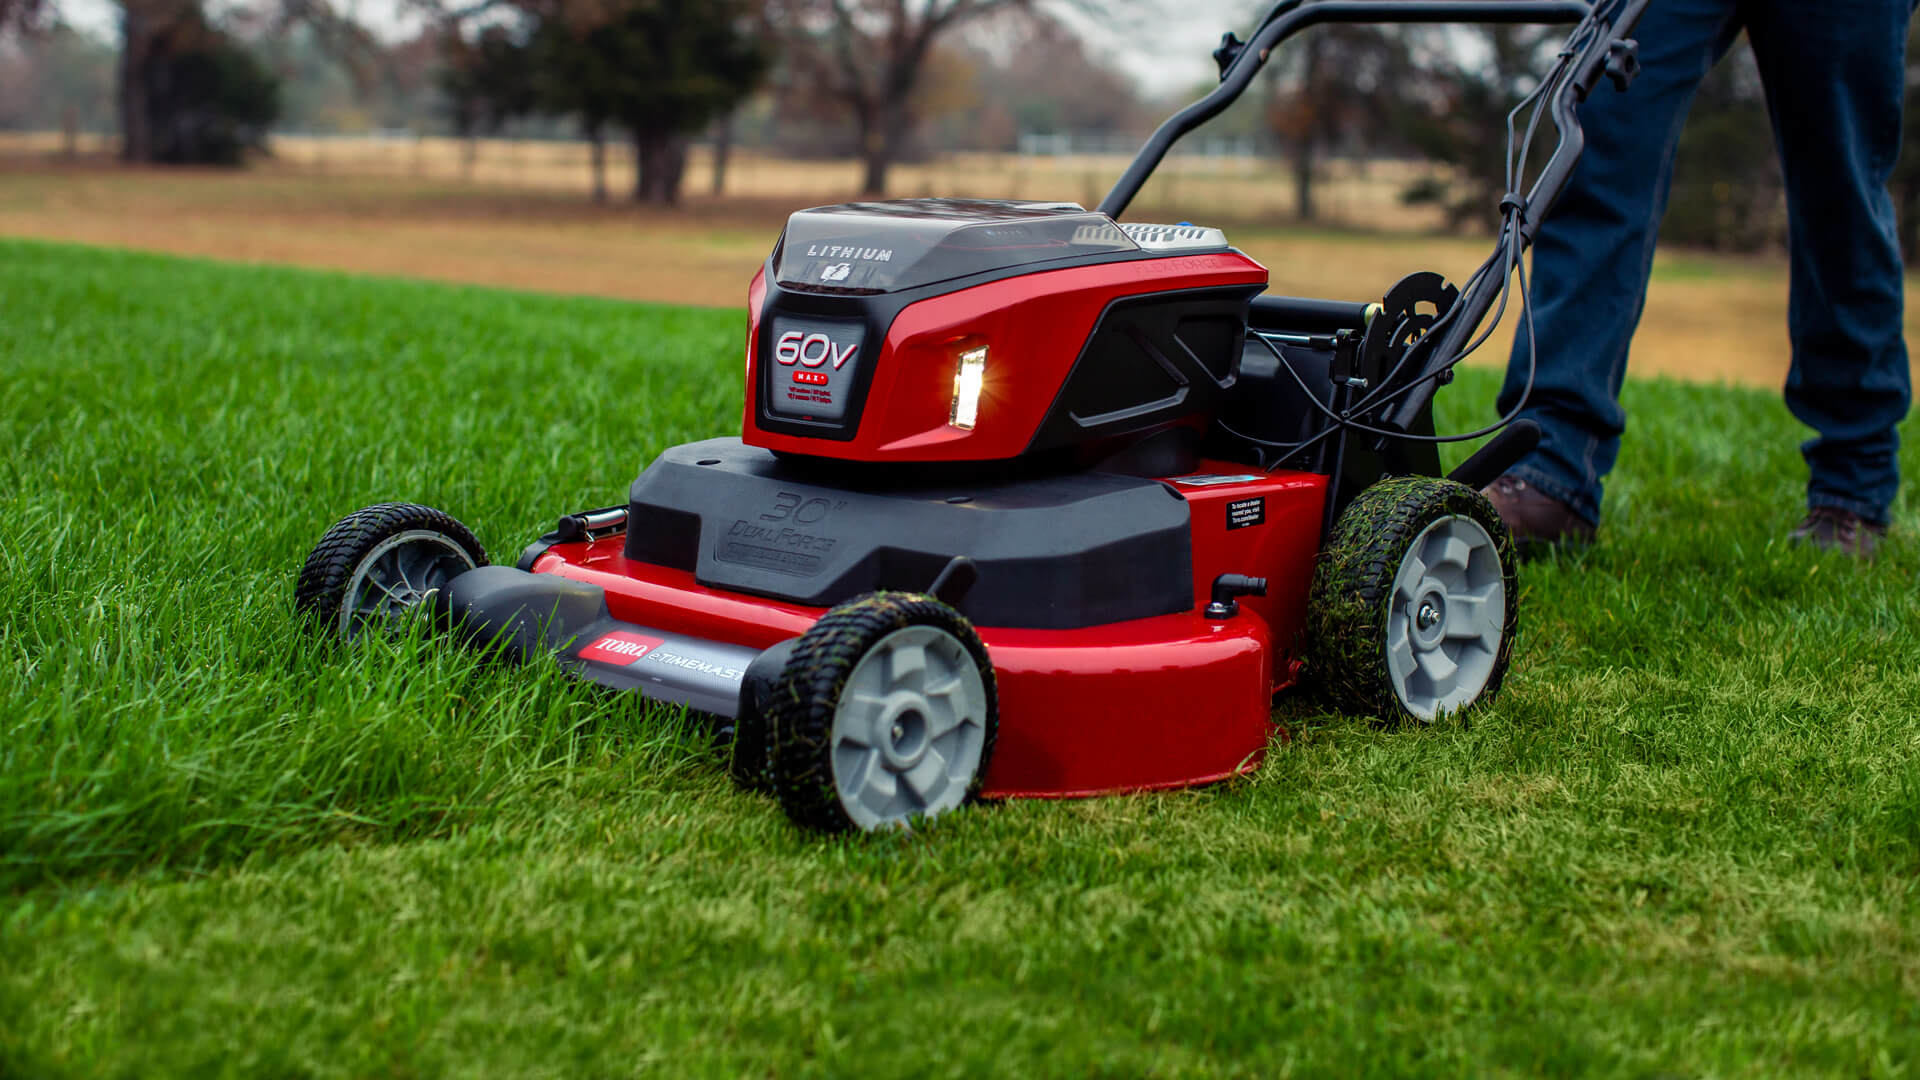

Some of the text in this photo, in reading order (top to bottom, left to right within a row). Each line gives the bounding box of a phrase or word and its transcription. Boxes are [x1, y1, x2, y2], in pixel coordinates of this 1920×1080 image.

[806, 244, 893, 262] LITHIUM
[595, 638, 648, 657] TORO
[648, 653, 745, 681] eTIMEMAST
